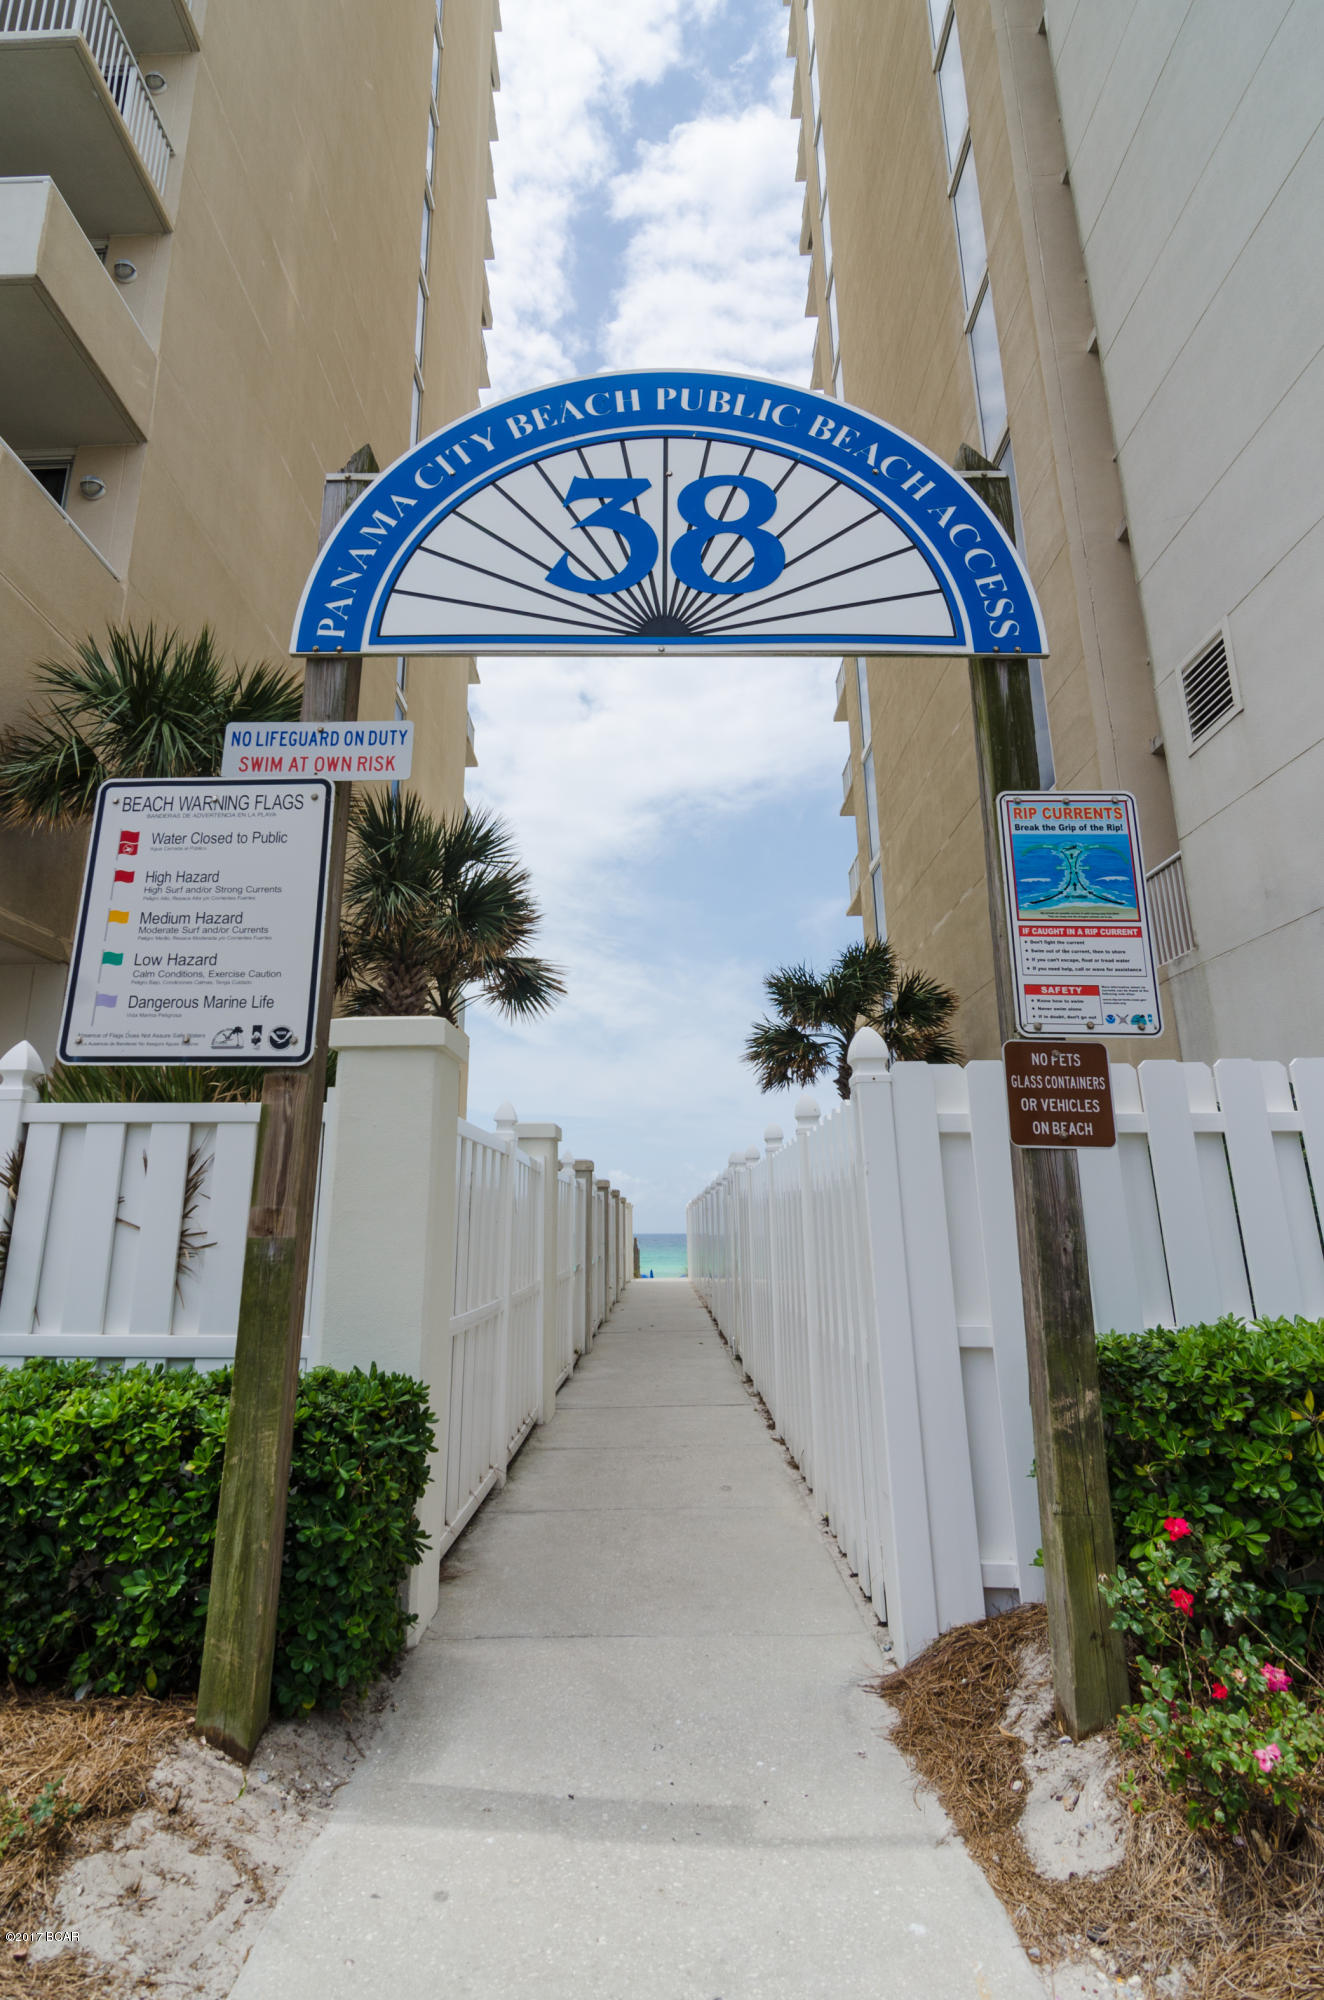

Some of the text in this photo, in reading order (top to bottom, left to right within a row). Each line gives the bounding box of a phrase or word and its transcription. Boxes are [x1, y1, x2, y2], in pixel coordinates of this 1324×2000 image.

[316, 387, 1020, 639] PANAMA CITY BEACH PUBLIC BEACH ACCESS
[545, 475, 786, 595] 38
[231, 730, 408, 747] NO LIFEGUARD ON DUTY
[238, 755, 396, 772] SWIM AT OWN RISK
[122, 794, 304, 812] BEACH WARNING FLAGS
[1013, 807, 1123, 820] RIP CURRENTS
[1014, 823, 1123, 833] Break the Grip of the Rip!
[151, 831, 288, 844] Water Closed to Public
[145, 870, 220, 886] High Hazard
[144, 886, 282, 895] High Surf and/or Strong Currents
[139, 911, 244, 925] Medium Hazard
[138, 926, 269, 934] Moderate Surf and/or Currents
[1085, 928, 1098, 936] RIP
[1100, 928, 1138, 936] CURRENT
[134, 953, 218, 966] Low Hazard
[132, 970, 282, 979] Calm Conditions, Exercise Caution
[1041, 986, 1082, 994] SAFETY
[128, 995, 274, 1011] Dangerous Marine Life
[1031, 1053, 1048, 1066] NO
[1010, 1075, 1106, 1090] GLASS CONTAINERS
[1020, 1098, 1100, 1113] OR VEHICLES
[1032, 1121, 1094, 1136] ON BEACH
